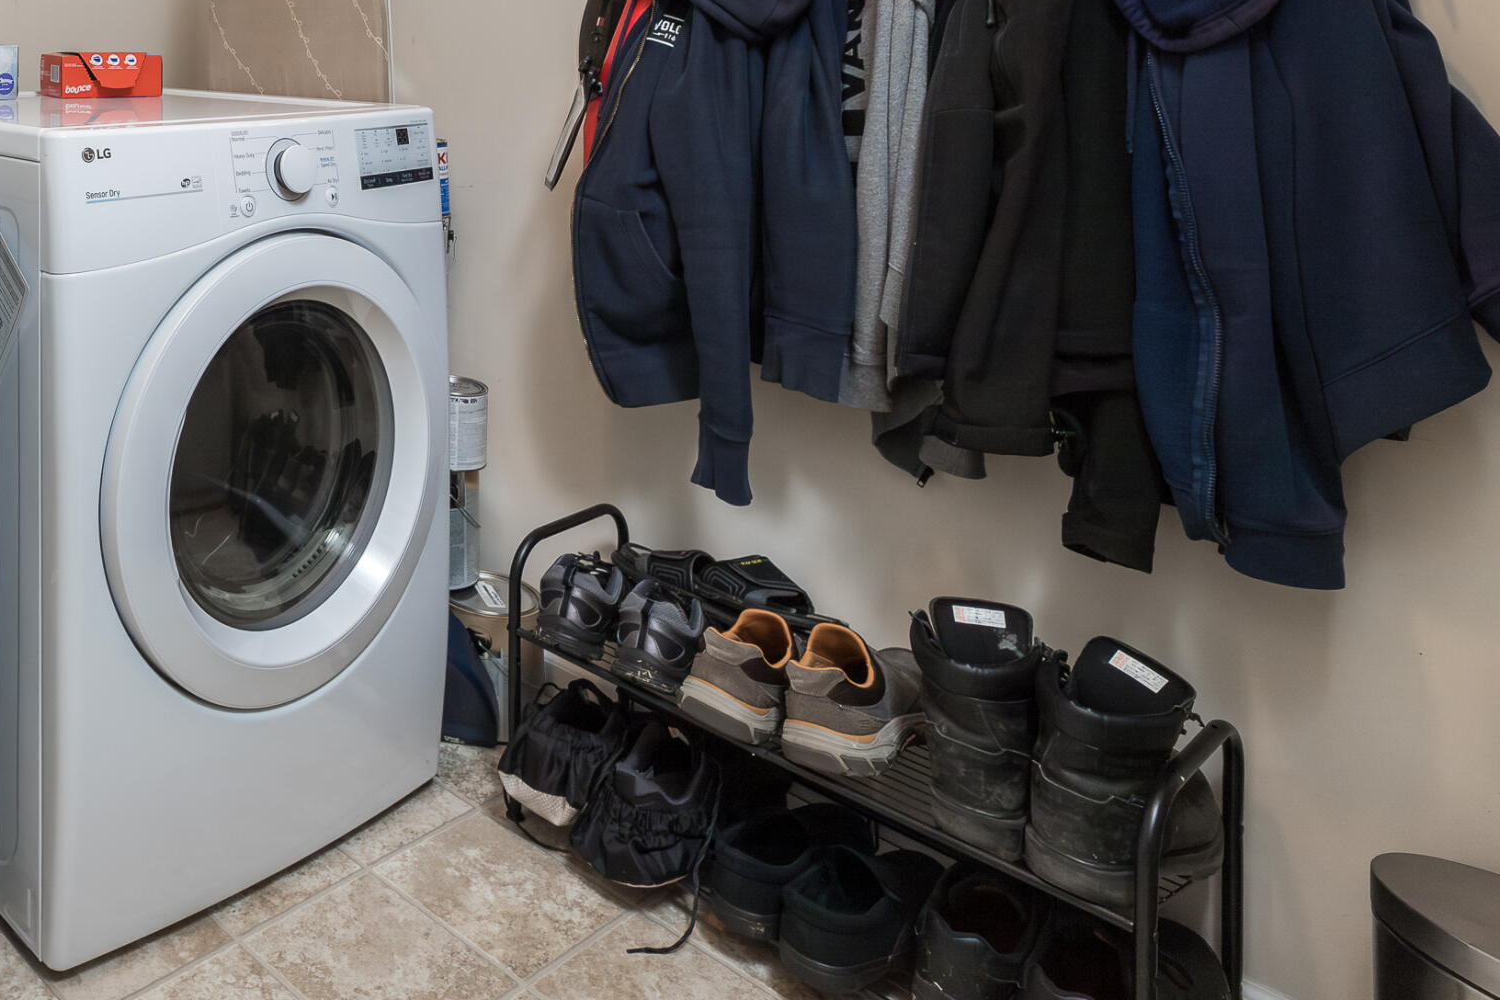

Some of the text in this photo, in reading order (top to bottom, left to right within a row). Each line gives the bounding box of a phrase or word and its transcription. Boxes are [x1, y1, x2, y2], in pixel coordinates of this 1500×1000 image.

[65, 84, 92, 95] bounce
[96, 147, 112, 160] LG
[85, 189, 121, 200] Sensor Dry
